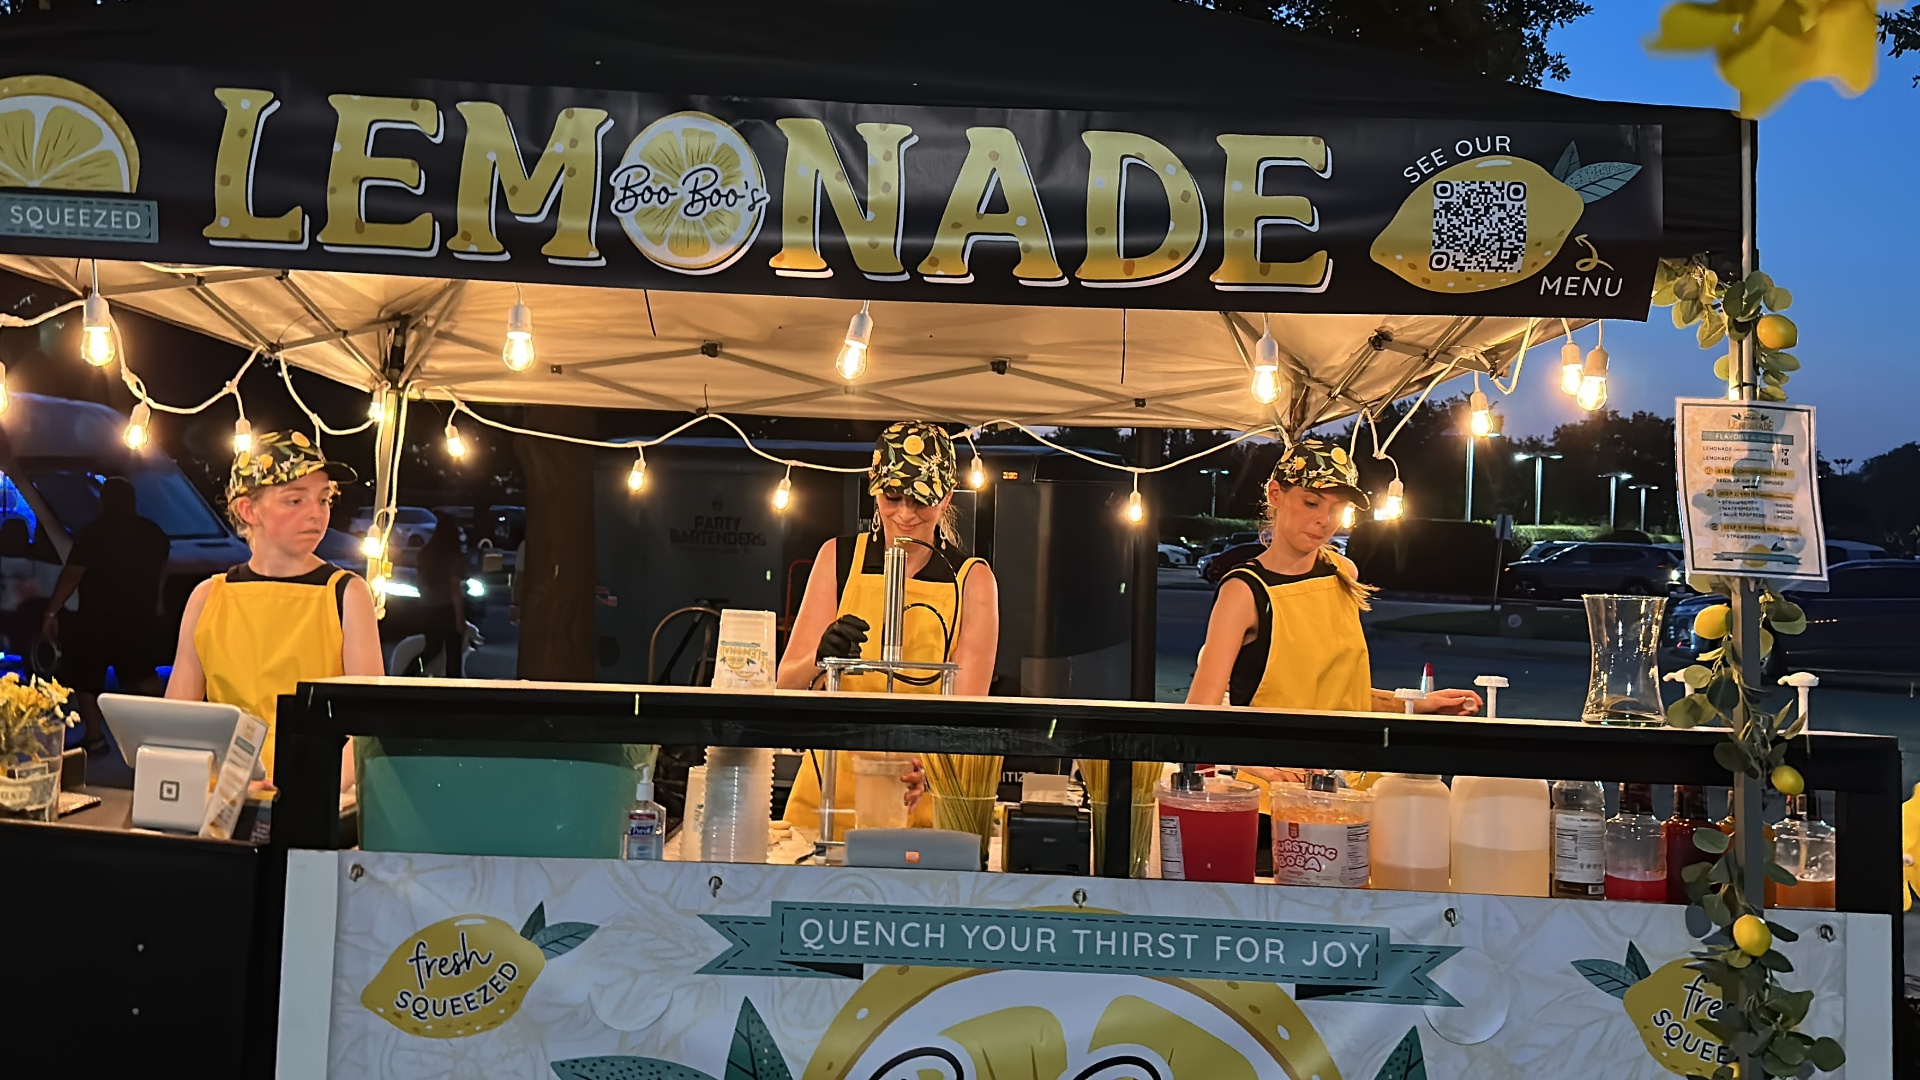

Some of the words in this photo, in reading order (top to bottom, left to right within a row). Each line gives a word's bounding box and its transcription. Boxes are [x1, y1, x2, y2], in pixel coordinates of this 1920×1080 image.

[1402, 147, 1449, 184] SEE
[1454, 134, 1512, 158] OUR
[10, 205, 141, 229] SQUEEZED
[612, 163, 676, 210] Boo
[680, 166, 768, 220] Boo's
[1539, 274, 1623, 298] MENU
[406, 931, 494, 990] fresh
[798, 917, 944, 951] QUENCH
[962, 924, 1057, 955] YOUR
[1078, 928, 1200, 960] THIRST
[1216, 934, 1286, 965] FOR
[1301, 941, 1371, 970] JOY
[394, 960, 519, 1021] SQUEEZED
